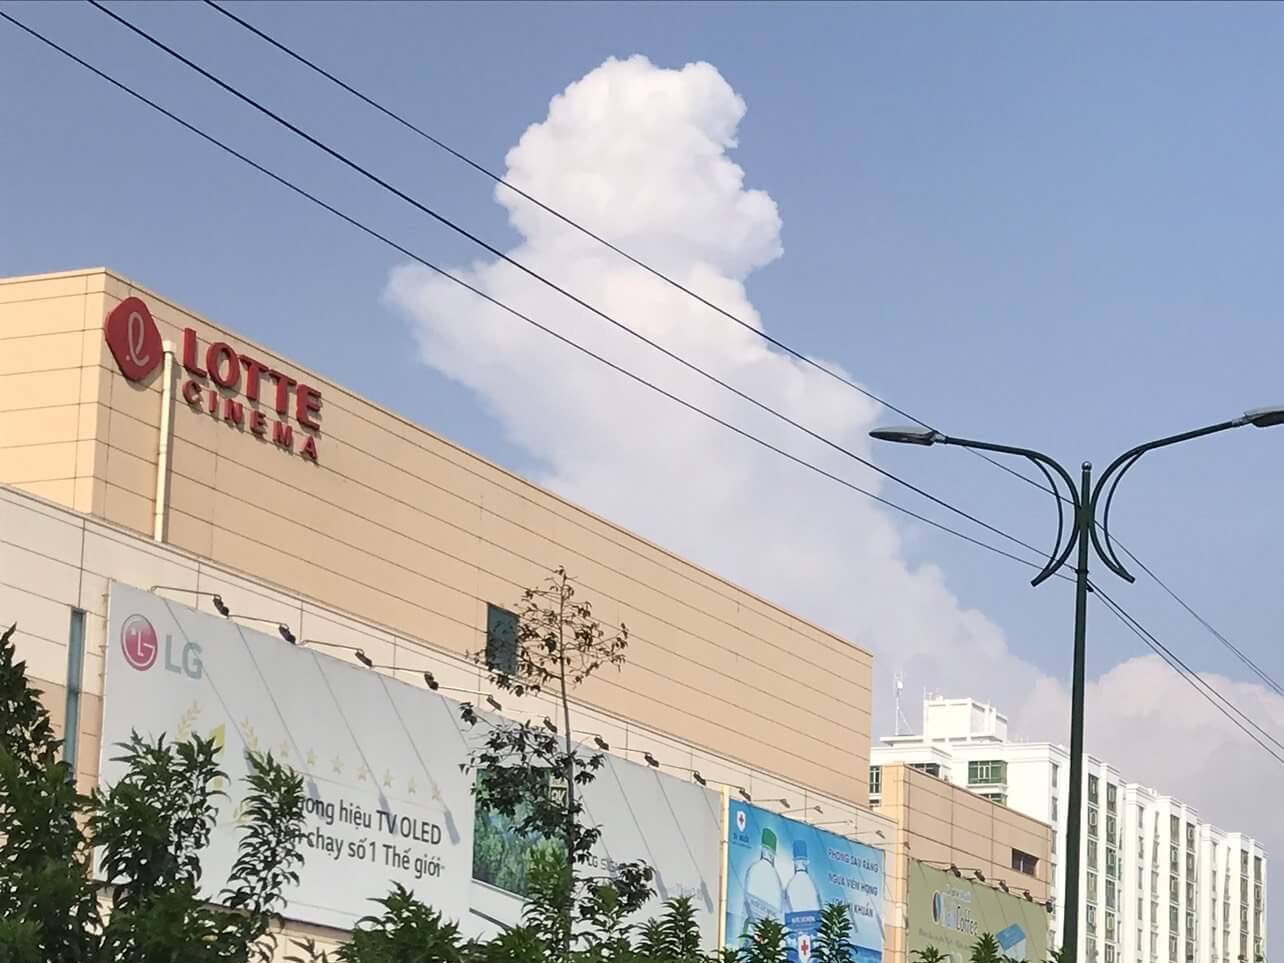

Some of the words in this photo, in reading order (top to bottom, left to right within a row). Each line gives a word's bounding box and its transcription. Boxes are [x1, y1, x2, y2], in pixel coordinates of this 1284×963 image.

[183, 327, 322, 432] LOTTE
[182, 379, 318, 461] CINEMA
[164, 635, 203, 679] LG
[338, 799, 372, 830] hiệu
[376, 809, 397, 834] TV
[400, 816, 441, 845] OLED
[382, 844, 410, 871] Thế
